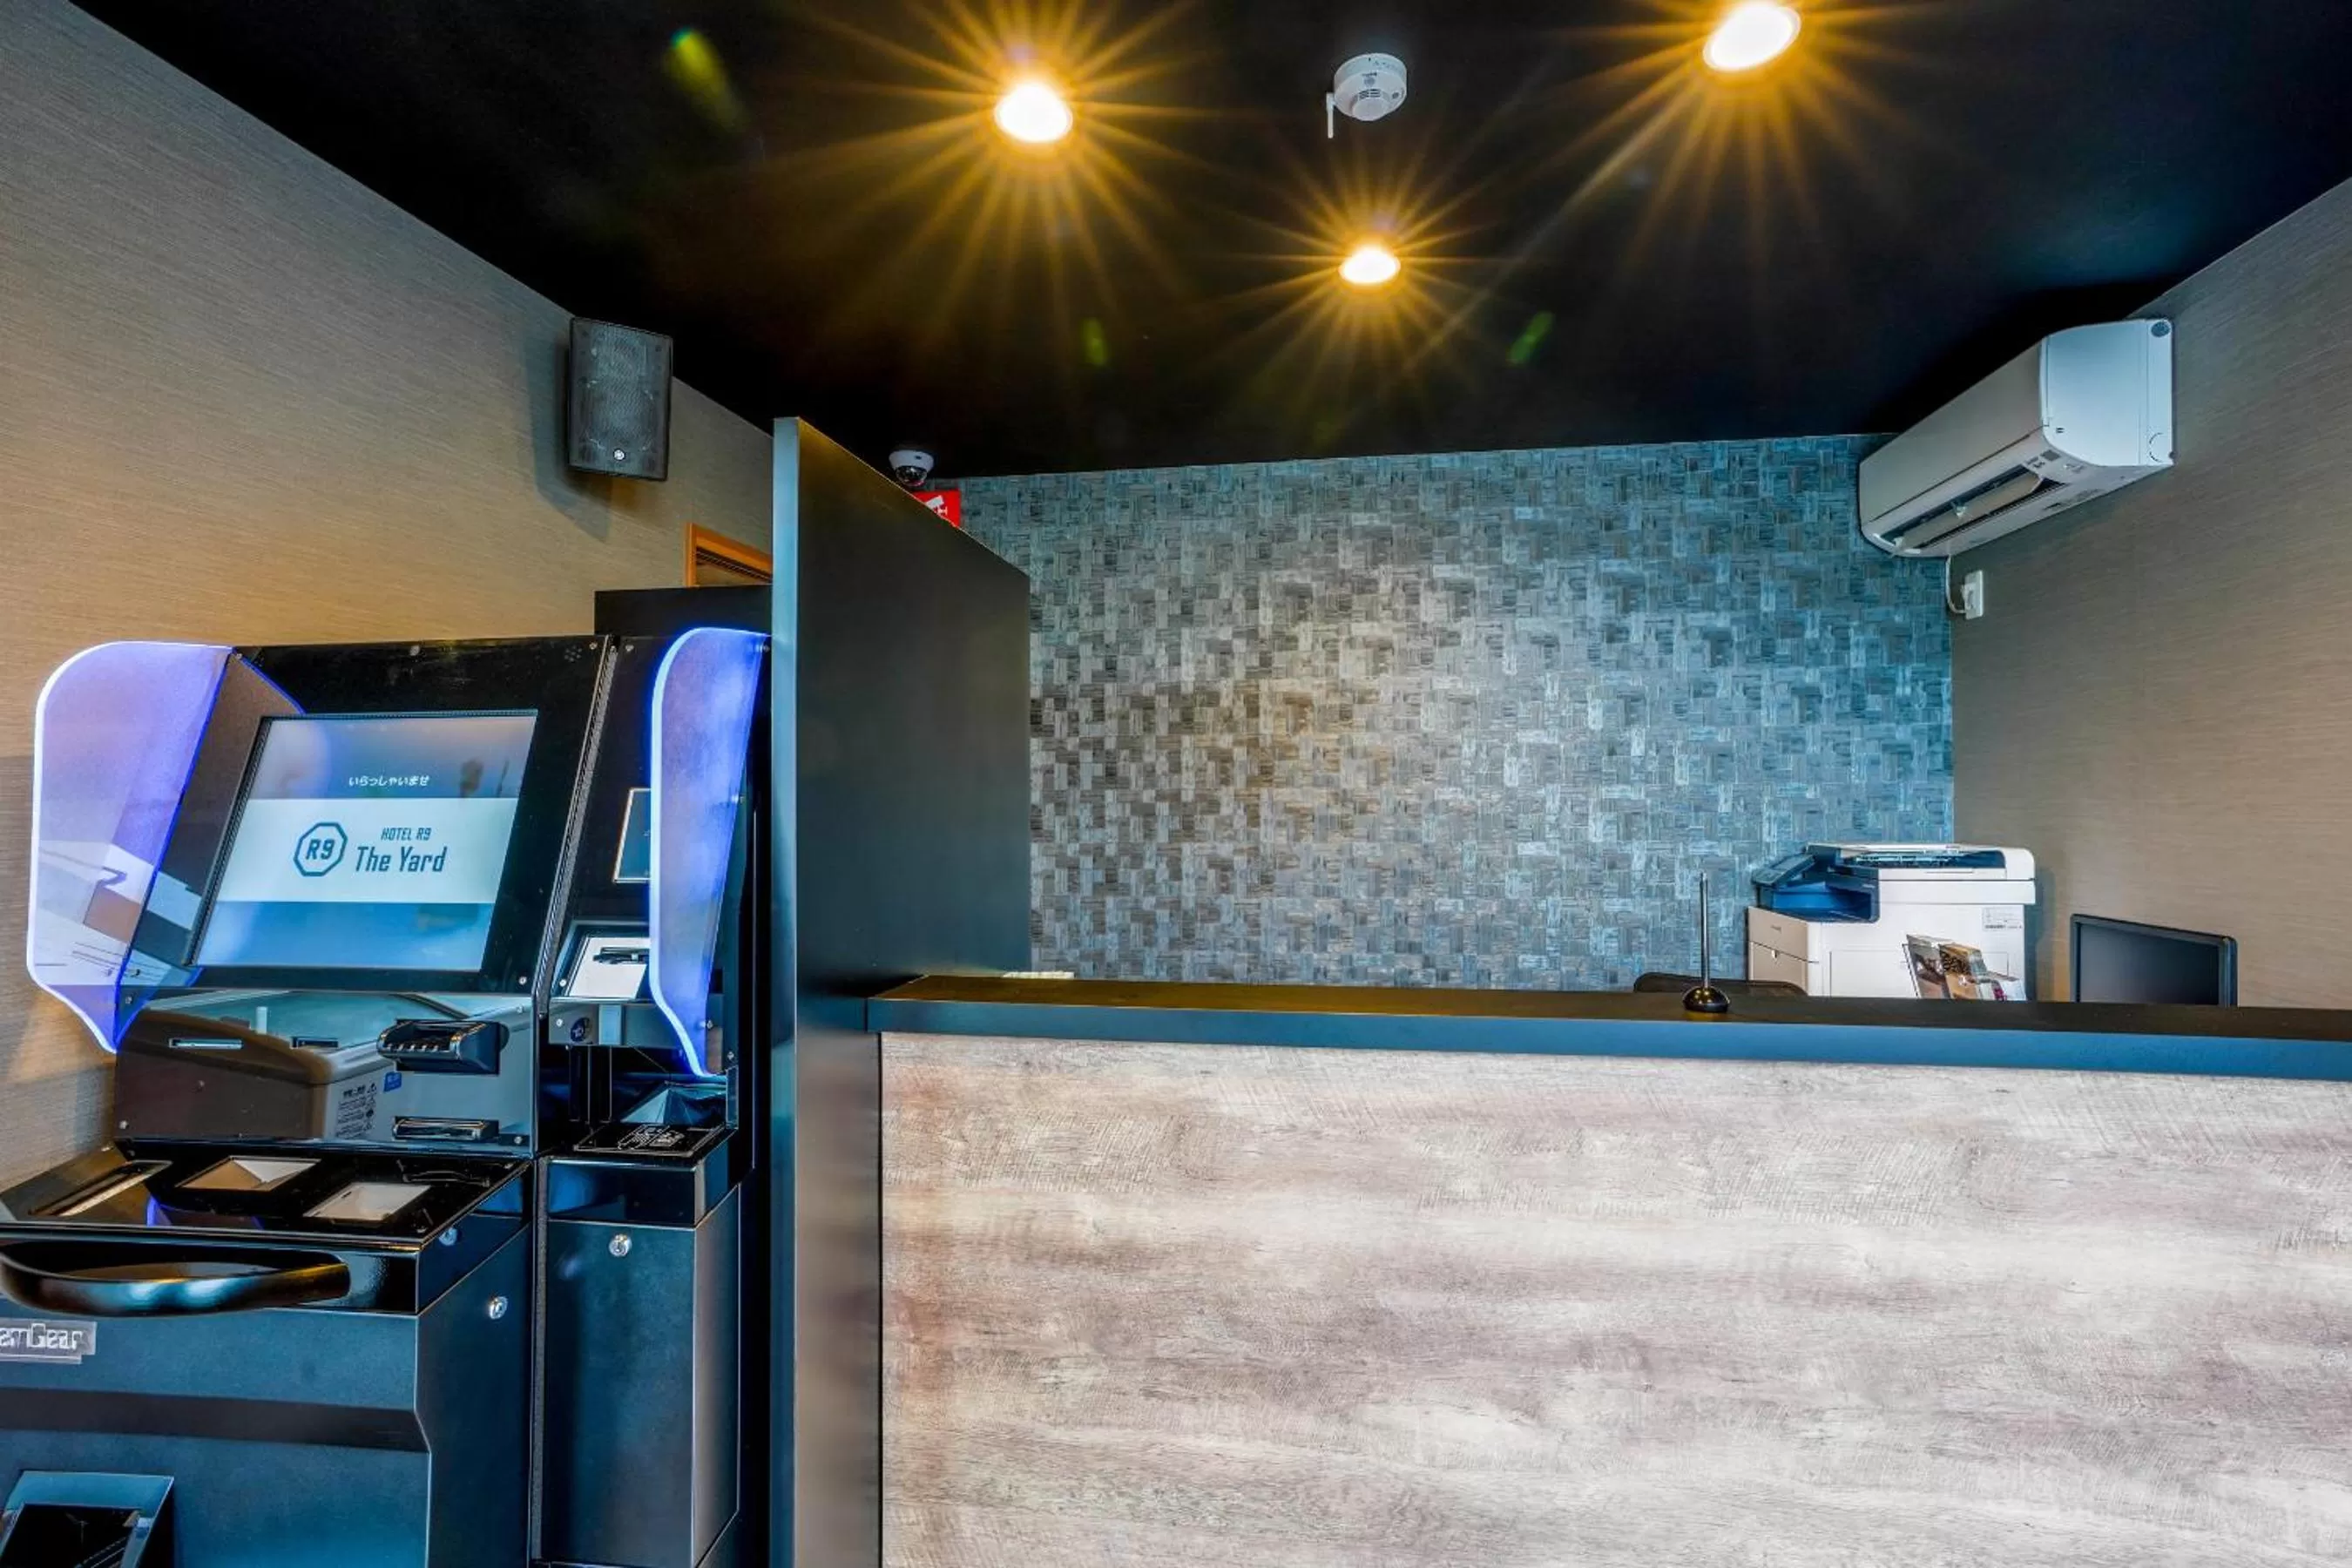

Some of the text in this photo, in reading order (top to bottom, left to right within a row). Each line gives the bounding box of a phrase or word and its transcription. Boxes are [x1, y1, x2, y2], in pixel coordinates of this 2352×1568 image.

[348, 774, 429, 787] いらっしゃいませ
[381, 828, 431, 841] HOTEL R9
[306, 839, 335, 860] R9
[355, 846, 447, 872] The Yard
